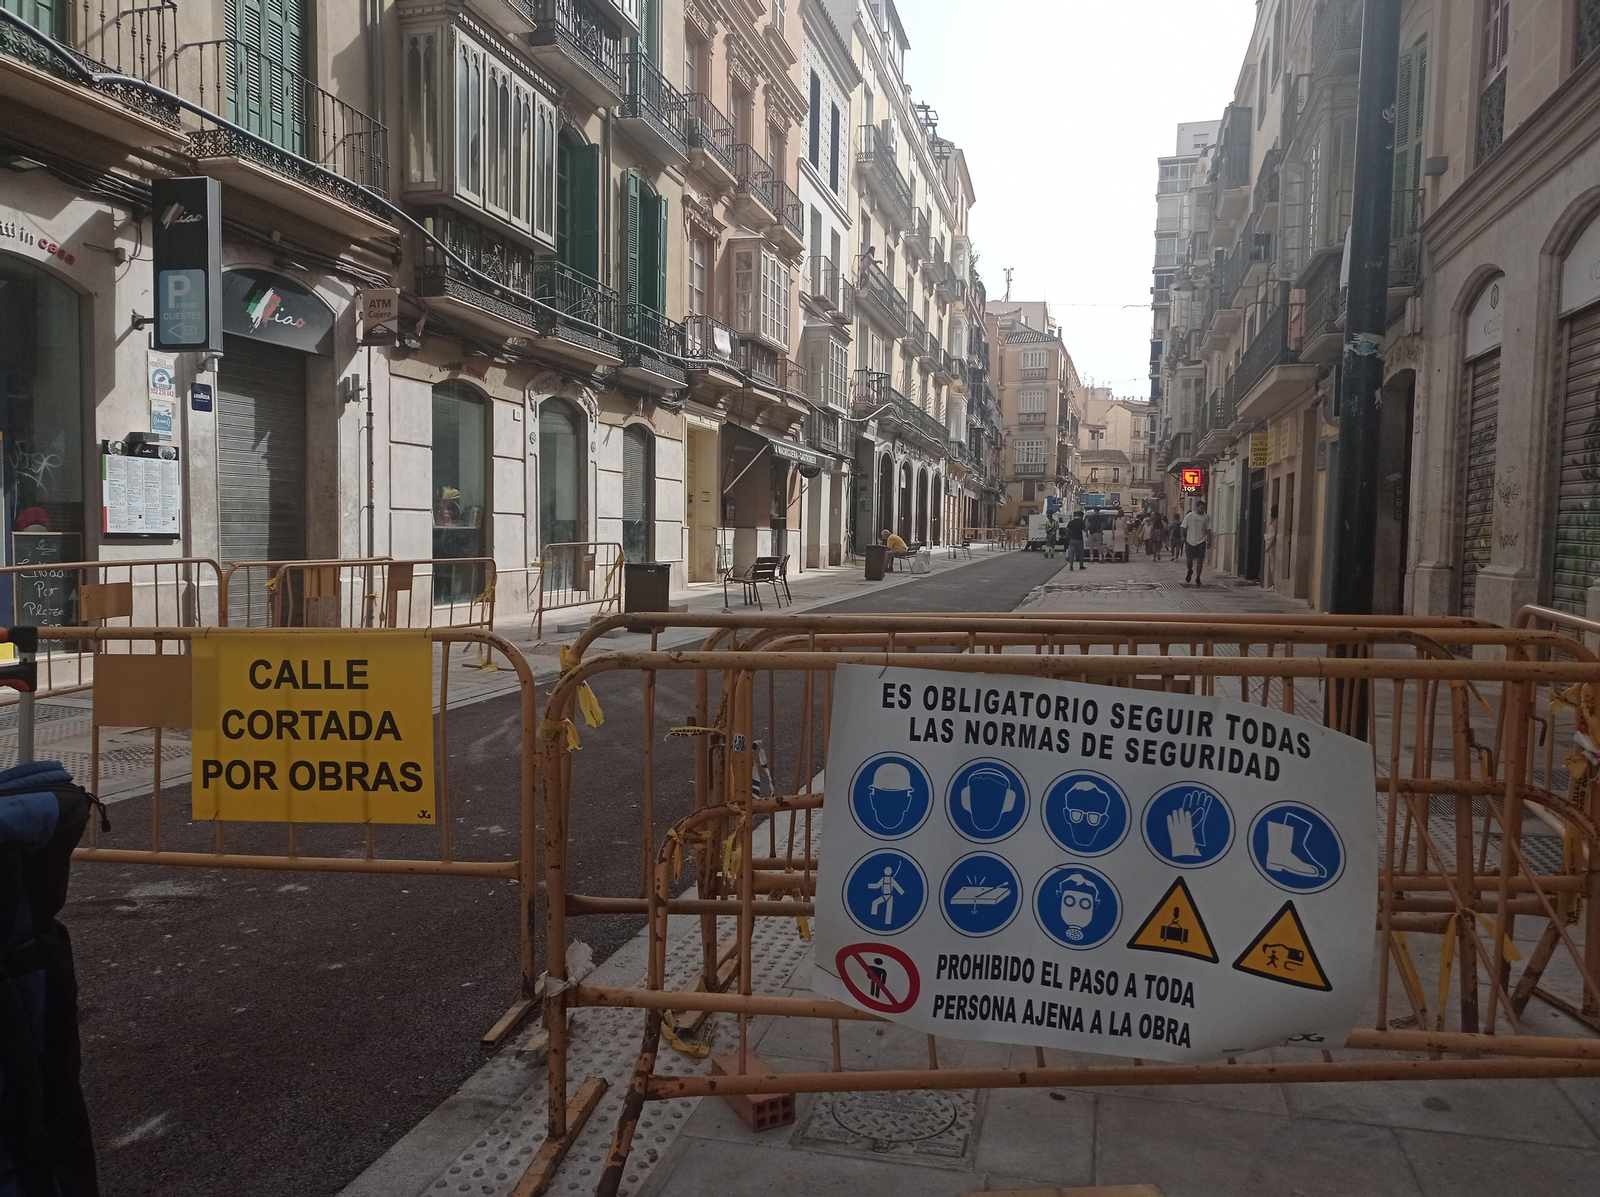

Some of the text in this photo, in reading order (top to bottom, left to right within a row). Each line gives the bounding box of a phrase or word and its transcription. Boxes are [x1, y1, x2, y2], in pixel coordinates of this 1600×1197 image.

[38, 238, 75, 266] casa
[163, 311, 202, 320] CLIENTES
[367, 310, 392, 319] Cajero
[368, 298, 392, 309] ATM
[248, 659, 369, 690] CALLE
[221, 709, 402, 741] CORTADA
[881, 682, 1312, 760] ES OBLIGATORIO SEGUIR TODAS
[909, 716, 1282, 783] LAS NORMAS DE SEGURIDAD
[202, 759, 424, 793] POR OBRAS
[936, 954, 1196, 1010] PROHIBIDO EL PASO A TODA
[932, 994, 1192, 1049] PERSONA AJENA A LA OBRA
